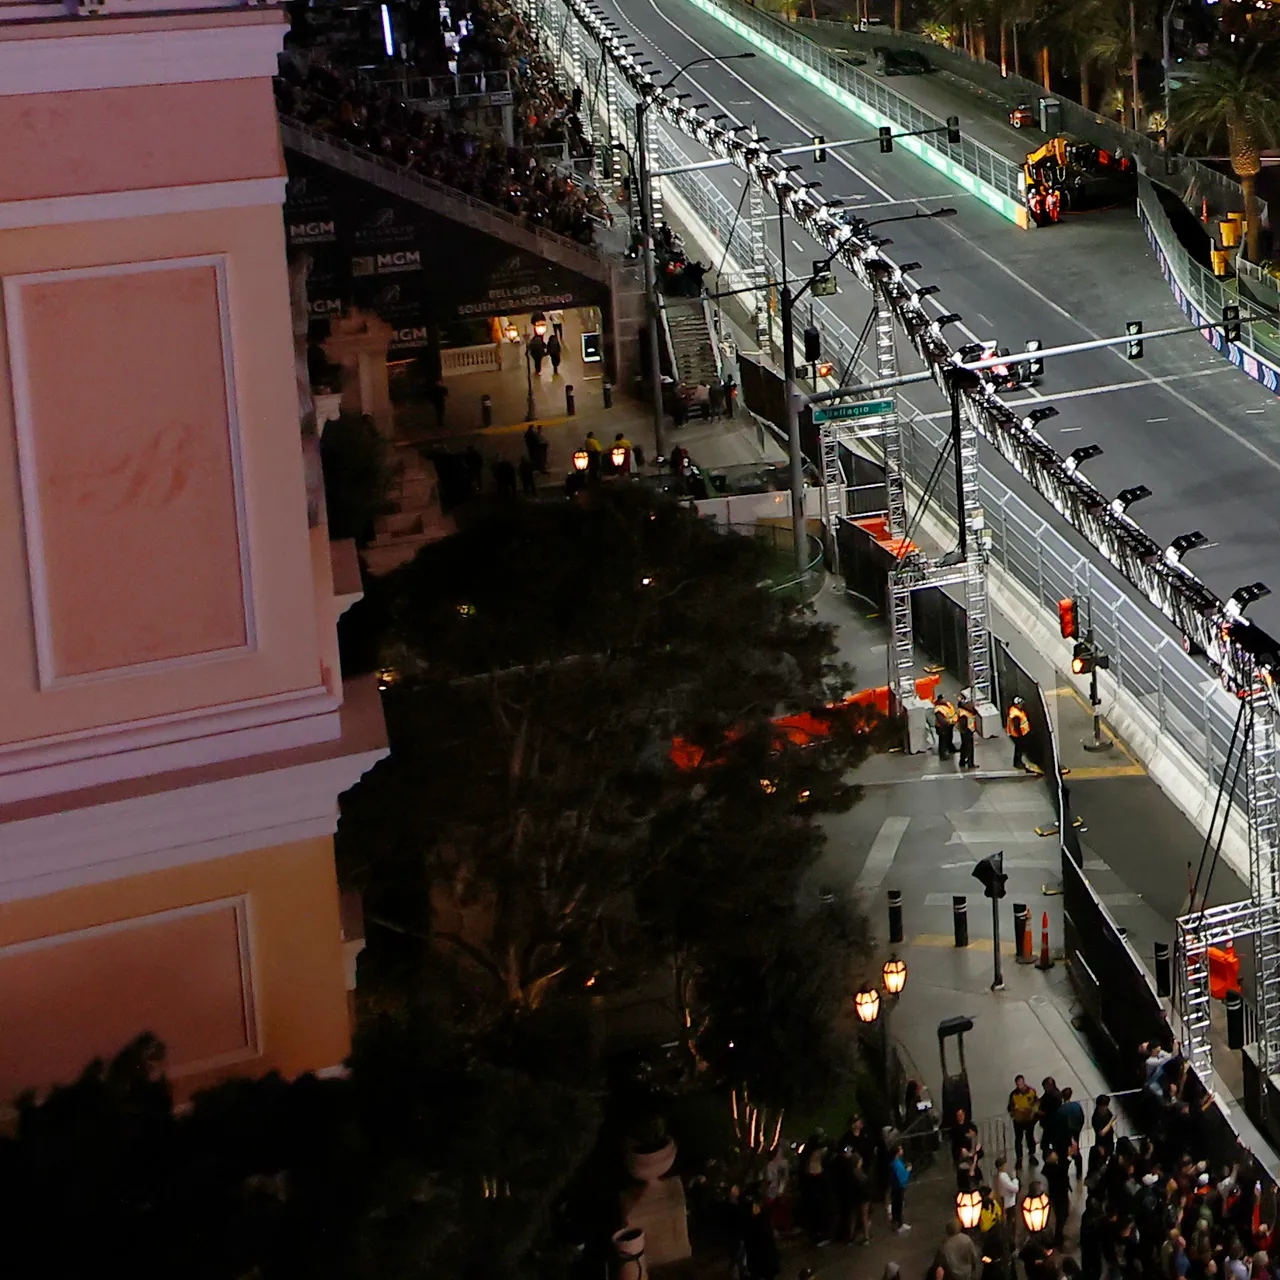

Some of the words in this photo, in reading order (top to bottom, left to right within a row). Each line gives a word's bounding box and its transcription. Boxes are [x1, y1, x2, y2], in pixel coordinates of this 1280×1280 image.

[290, 220, 336, 237] MGM
[376, 250, 421, 267] MGM
[826, 406, 869, 418] Bellagio
